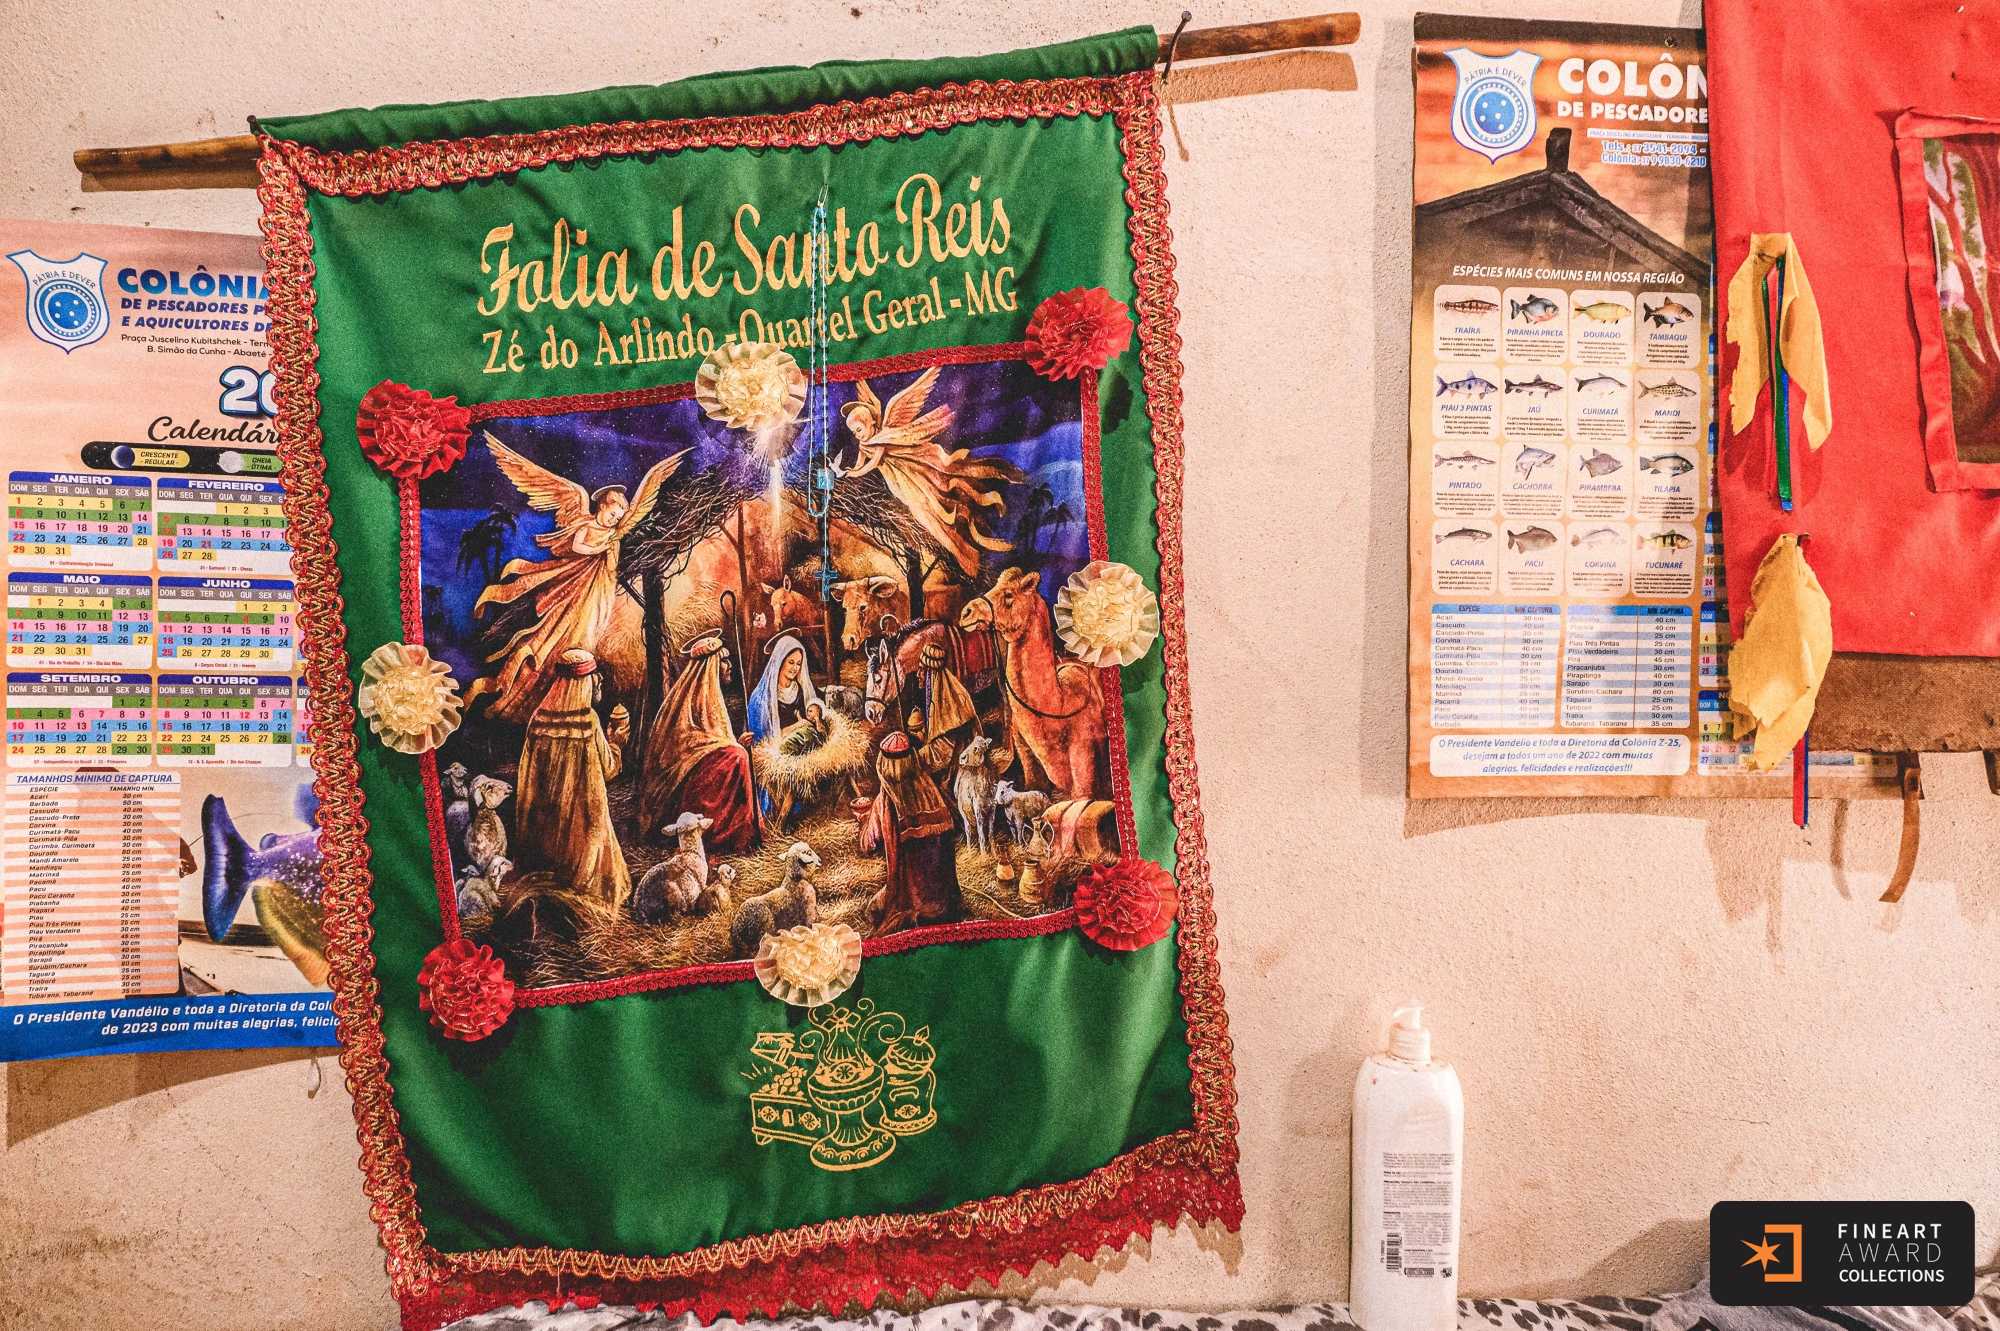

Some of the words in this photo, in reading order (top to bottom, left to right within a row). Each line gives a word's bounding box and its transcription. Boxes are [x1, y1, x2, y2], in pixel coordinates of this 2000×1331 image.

[1465, 67, 1492, 84] PÁTRIA
[1502, 68, 1526, 87] DEVER
[1558, 101, 1583, 117] DE
[1591, 102, 1708, 123] PESCADORE
[1643, 142, 1696, 154] 3541-2094
[1652, 156, 1656, 164] 9
[1659, 156, 1705, 166] 9830-6210
[652, 206, 723, 300] de
[733, 204, 889, 296] Santo
[895, 173, 1011, 268] Reis
[1453, 264, 1503, 277] ESPÉCIES
[1505, 267, 1533, 279] MAIS
[1535, 269, 1582, 280] COMUNS
[1585, 271, 1602, 281] EM
[1604, 272, 1640, 283] NOSSA
[1643, 271, 1684, 284] REGIÃO
[32, 271, 60, 286] PÁTRIA
[70, 272, 96, 289] DEVER
[121, 298, 142, 309] DE
[147, 300, 248, 314] PESCADORES
[121, 316, 131, 326] E
[135, 316, 249, 331] AQUICULTORES
[482, 329, 525, 374] Zé
[540, 325, 579, 369] do
[594, 313, 714, 366] Arlindo
[863, 276, 946, 334] Geral
[121, 334, 146, 342] Praça
[149, 335, 189, 344] Juscelino
[192, 337, 241, 346] Kubitshchek
[158, 346, 184, 354] Simão
[233, 349, 266, 357] Abaeté
[1527, 405, 1541, 413] JAÚ
[1582, 407, 1619, 415] CURIMATÁ
[140, 451, 178, 459] CRESCENTE
[50, 475, 112, 484] JANEIRO
[188, 480, 264, 491] FEVEREIRO
[135, 488, 149, 496] SÁB
[14, 521, 24, 529] 15
[35, 522, 45, 530] 16
[138, 526, 147, 534] 21
[1645, 560, 1683, 569] TUCUNARÉ
[63, 575, 100, 583] MAIO
[202, 579, 250, 588] JUNHO
[40, 674, 122, 683] SETEMBRO
[192, 676, 258, 685] OUTUBRO
[1447, 739, 1492, 747] Presidente
[1495, 739, 1530, 747] Vandélio
[1609, 738, 1620, 746] da
[1658, 739, 1681, 747] Z-25,
[1463, 752, 1497, 762] desejam
[1566, 751, 1576, 759] de
[1483, 765, 1518, 774] alegrias,
[1521, 764, 1566, 772] felicidades
[17, 775, 73, 783] TAMANHOS
[75, 773, 112, 783] MÍNIMO
[13, 1014, 24, 1025] O
[27, 1009, 106, 1024] Presidente
[110, 1006, 168, 1019] Vandélio
[173, 1006, 180, 1015] e
[185, 1004, 214, 1015] toda
[218, 1005, 225, 1013] a
[229, 1002, 286, 1013] Diretoria
[290, 1001, 305, 1011] da
[101, 1025, 118, 1035] de
[122, 1022, 157, 1034] 2023
[161, 1022, 190, 1032] com
[193, 1019, 239, 1030] muitas
[242, 1017, 297, 1030] alegrias,
